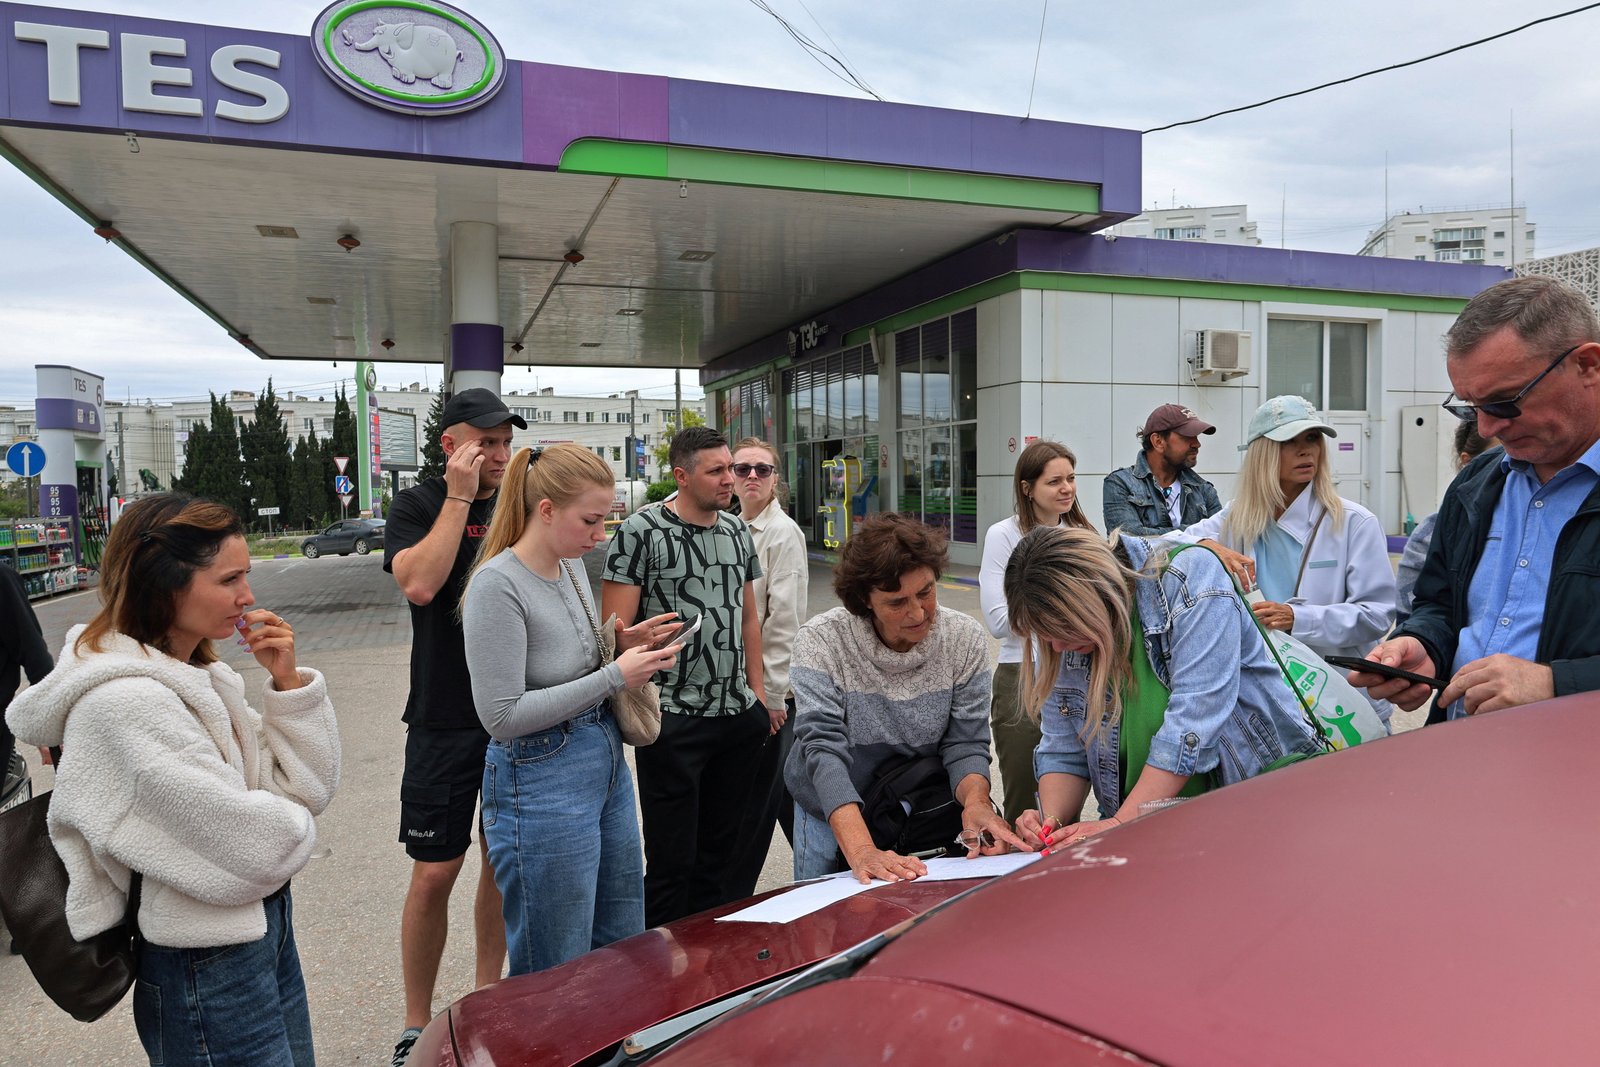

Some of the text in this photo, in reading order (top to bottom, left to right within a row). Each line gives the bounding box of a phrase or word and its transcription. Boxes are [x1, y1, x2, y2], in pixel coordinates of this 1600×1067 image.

[14, 20, 290, 124] TES
[73, 377, 87, 393] TES
[96, 384, 103, 407] 6
[49, 486, 60, 495] 95
[50, 497, 60, 506] 95
[51, 507, 61, 516] 92
